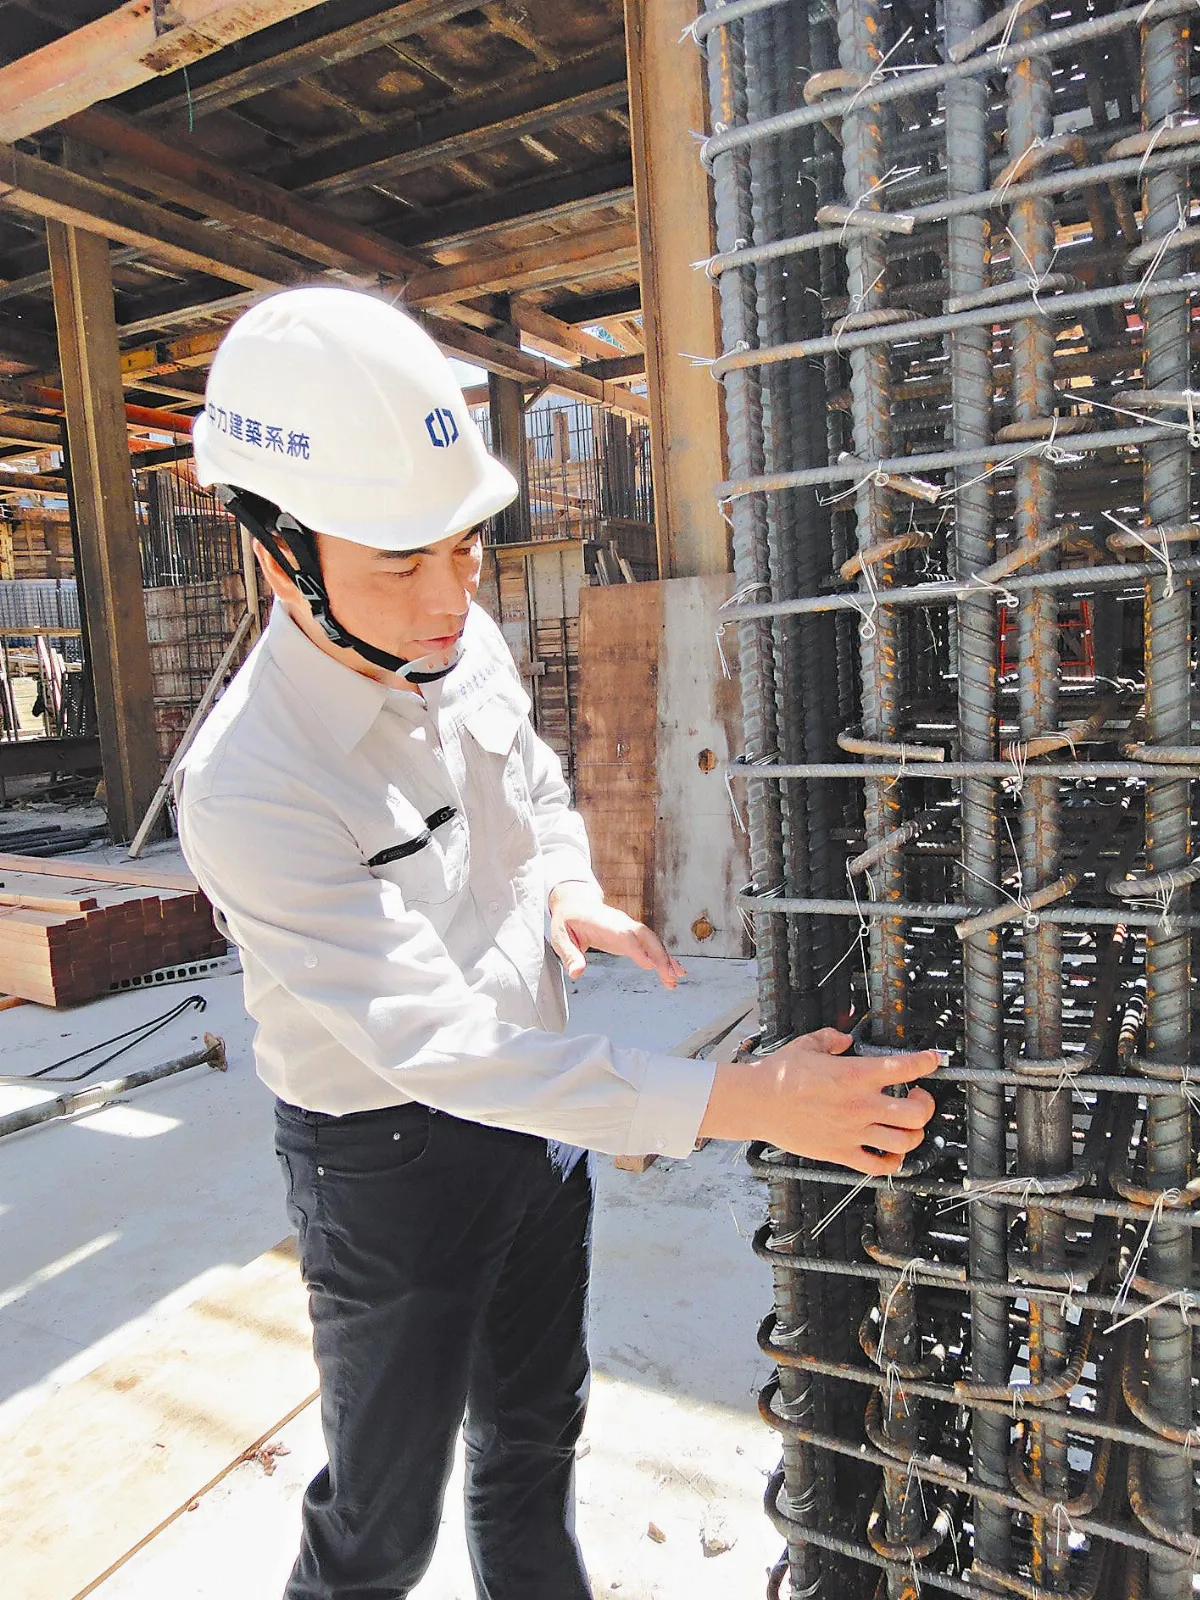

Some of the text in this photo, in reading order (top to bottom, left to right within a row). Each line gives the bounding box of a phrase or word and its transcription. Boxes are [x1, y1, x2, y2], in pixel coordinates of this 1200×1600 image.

[207, 402, 310, 460] 中力建築系統
